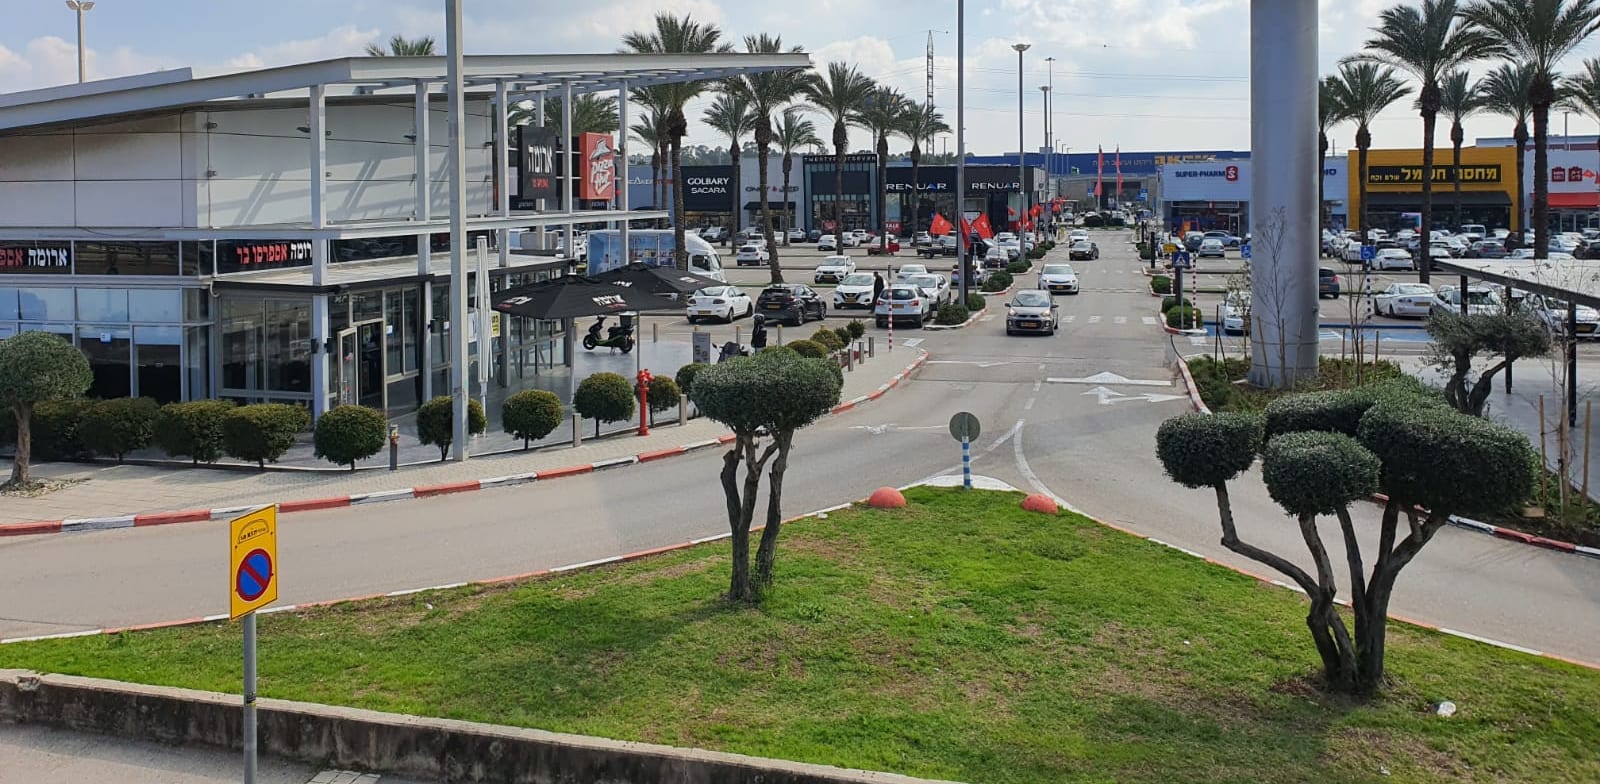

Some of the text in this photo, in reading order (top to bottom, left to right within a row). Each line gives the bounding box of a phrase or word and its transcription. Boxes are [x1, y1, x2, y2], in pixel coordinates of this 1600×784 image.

[528, 144, 553, 174] ארומה
[1175, 170, 1226, 178] SUPER-PHARM
[687, 176, 730, 185] GOLBARY
[886, 183, 947, 191] RENUAR
[972, 182, 1020, 190] RENUAR
[28, 247, 68, 267] ארומה
[236, 241, 313, 264] רומה אספרסו בר
